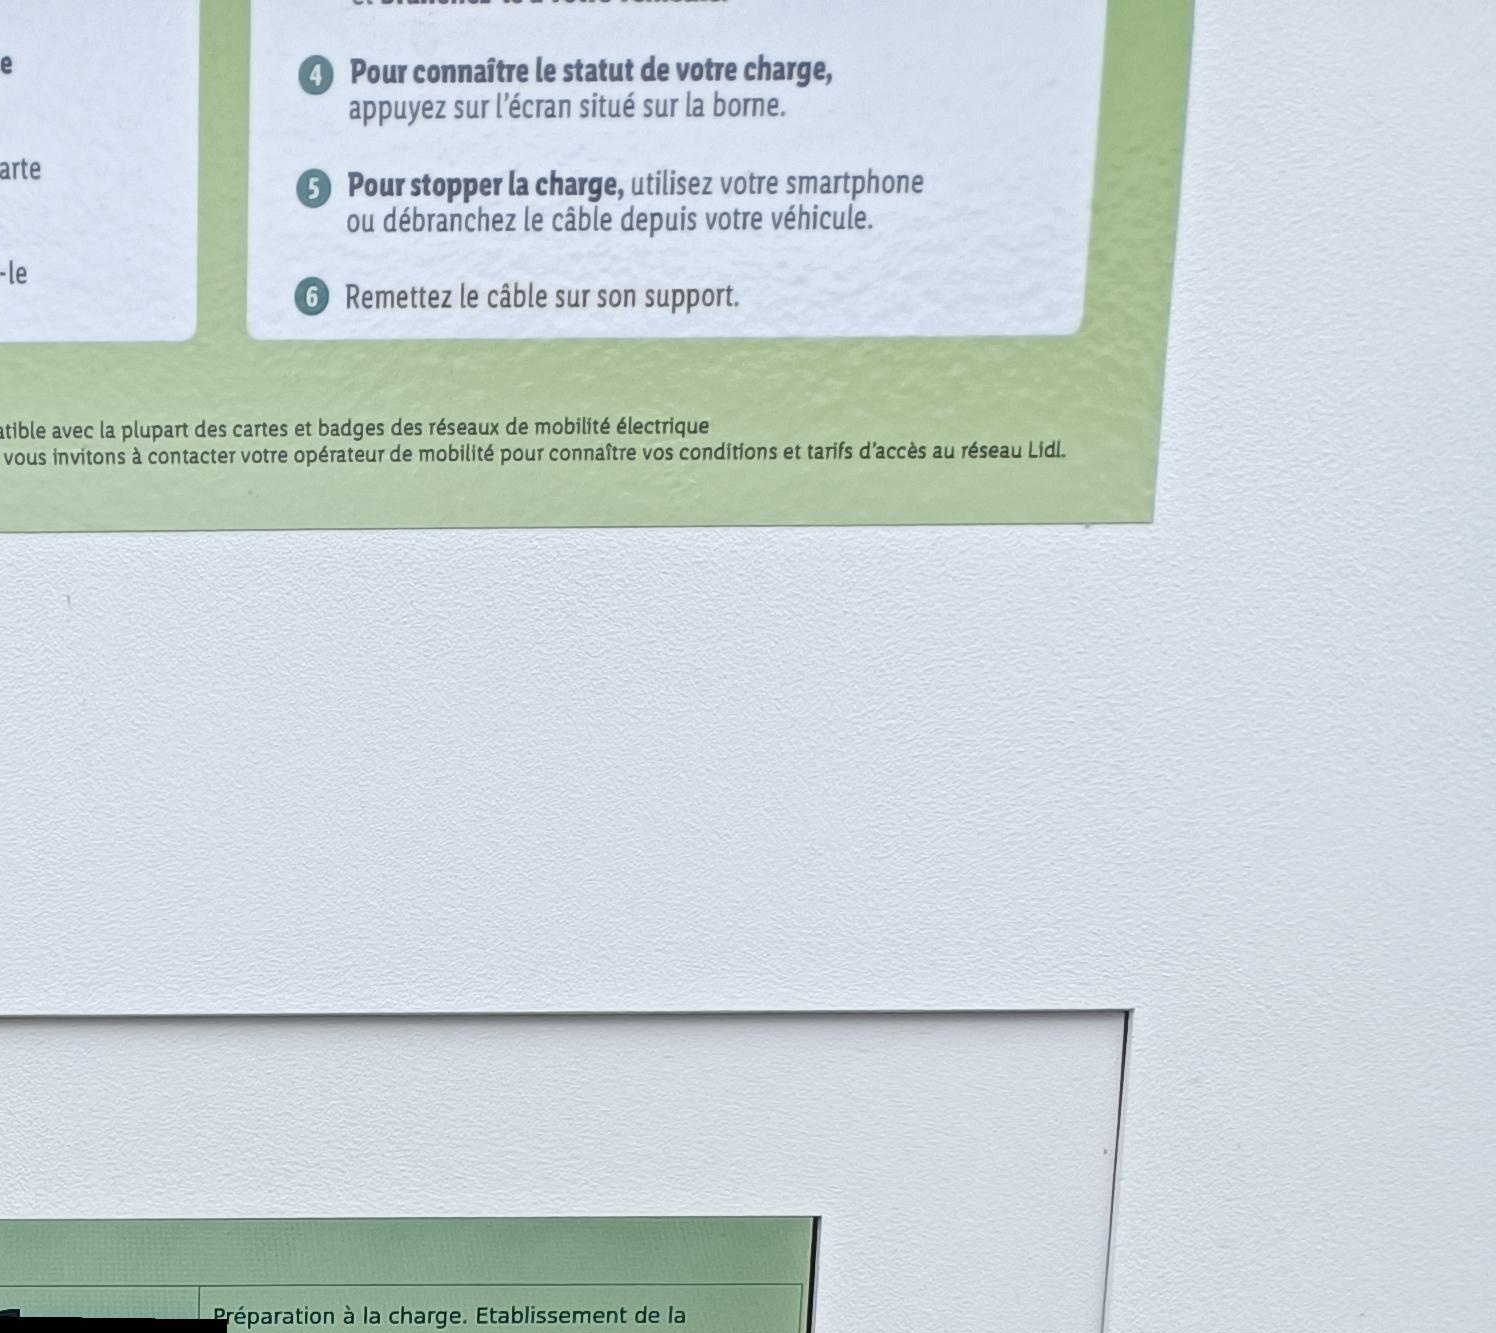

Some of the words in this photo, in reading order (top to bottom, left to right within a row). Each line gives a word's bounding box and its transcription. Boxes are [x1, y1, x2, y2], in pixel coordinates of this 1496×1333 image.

[308, 63, 324, 86] 4
[349, 57, 408, 85] Pour
[412, 57, 529, 84] connaître
[535, 55, 557, 83] le
[562, 58, 635, 83] statut
[640, 54, 670, 83] de
[675, 57, 738, 82] votre
[743, 53, 833, 88] charge,
[349, 99, 447, 127] appuyez
[453, 99, 491, 120] sur
[579, 91, 636, 119] situé
[642, 97, 680, 119] sur
[685, 90, 705, 118] la
[713, 90, 786, 118] borne.
[307, 177, 320, 201] 5
[347, 171, 406, 198] Pour
[410, 173, 504, 204] stopper
[508, 169, 530, 197] la
[535, 169, 625, 203] charge,
[631, 169, 713, 196] utilisez
[720, 172, 779, 196] votre
[786, 167, 924, 201] smartphone
[305, 284, 319, 309] 6
[345, 283, 453, 310] Remettez
[460, 282, 479, 309] le
[487, 281, 548, 309] câble
[555, 288, 591, 309] sur
[596, 288, 636, 309] son
[644, 284, 740, 315] support.
[51, 425, 94, 440] avec
[100, 420, 116, 439] la
[121, 419, 189, 443] plupart
[194, 419, 227, 438] des
[232, 421, 288, 438] cartes
[294, 421, 312, 437] et
[318, 417, 385, 442] badges
[390, 417, 423, 436] des
[428, 417, 500, 436] réseaux
[505, 416, 529, 436] de
[534, 416, 611, 435] mobilité
[616, 415, 710, 439] électrique
[3, 451, 47, 466] vous
[52, 447, 126, 466] invitons
[131, 446, 143, 465] à
[147, 448, 237, 465] contacter
[240, 448, 288, 464] votre
[293, 444, 386, 468] opérateur
[389, 443, 413, 463] de
[418, 443, 495, 463] mobilité
[499, 447, 545, 466] pour
[548, 442, 637, 462] connaître
[642, 446, 674, 461] vos
[678, 441, 778, 461] conditions
[782, 444, 802, 461] et
[807, 440, 853, 460] tarifs
[932, 445, 955, 460] au
[961, 440, 1023, 459] réseau
[1028, 439, 1067, 459] Lidl.
[214, 1306, 335, 1331] Préparation
[343, 1304, 355, 1325] à
[363, 1305, 381, 1325] la
[388, 1305, 467, 1330] charge.
[476, 1305, 628, 1325] Etablissement
[634, 1305, 661, 1324] de
[668, 1305, 686, 1324] la
